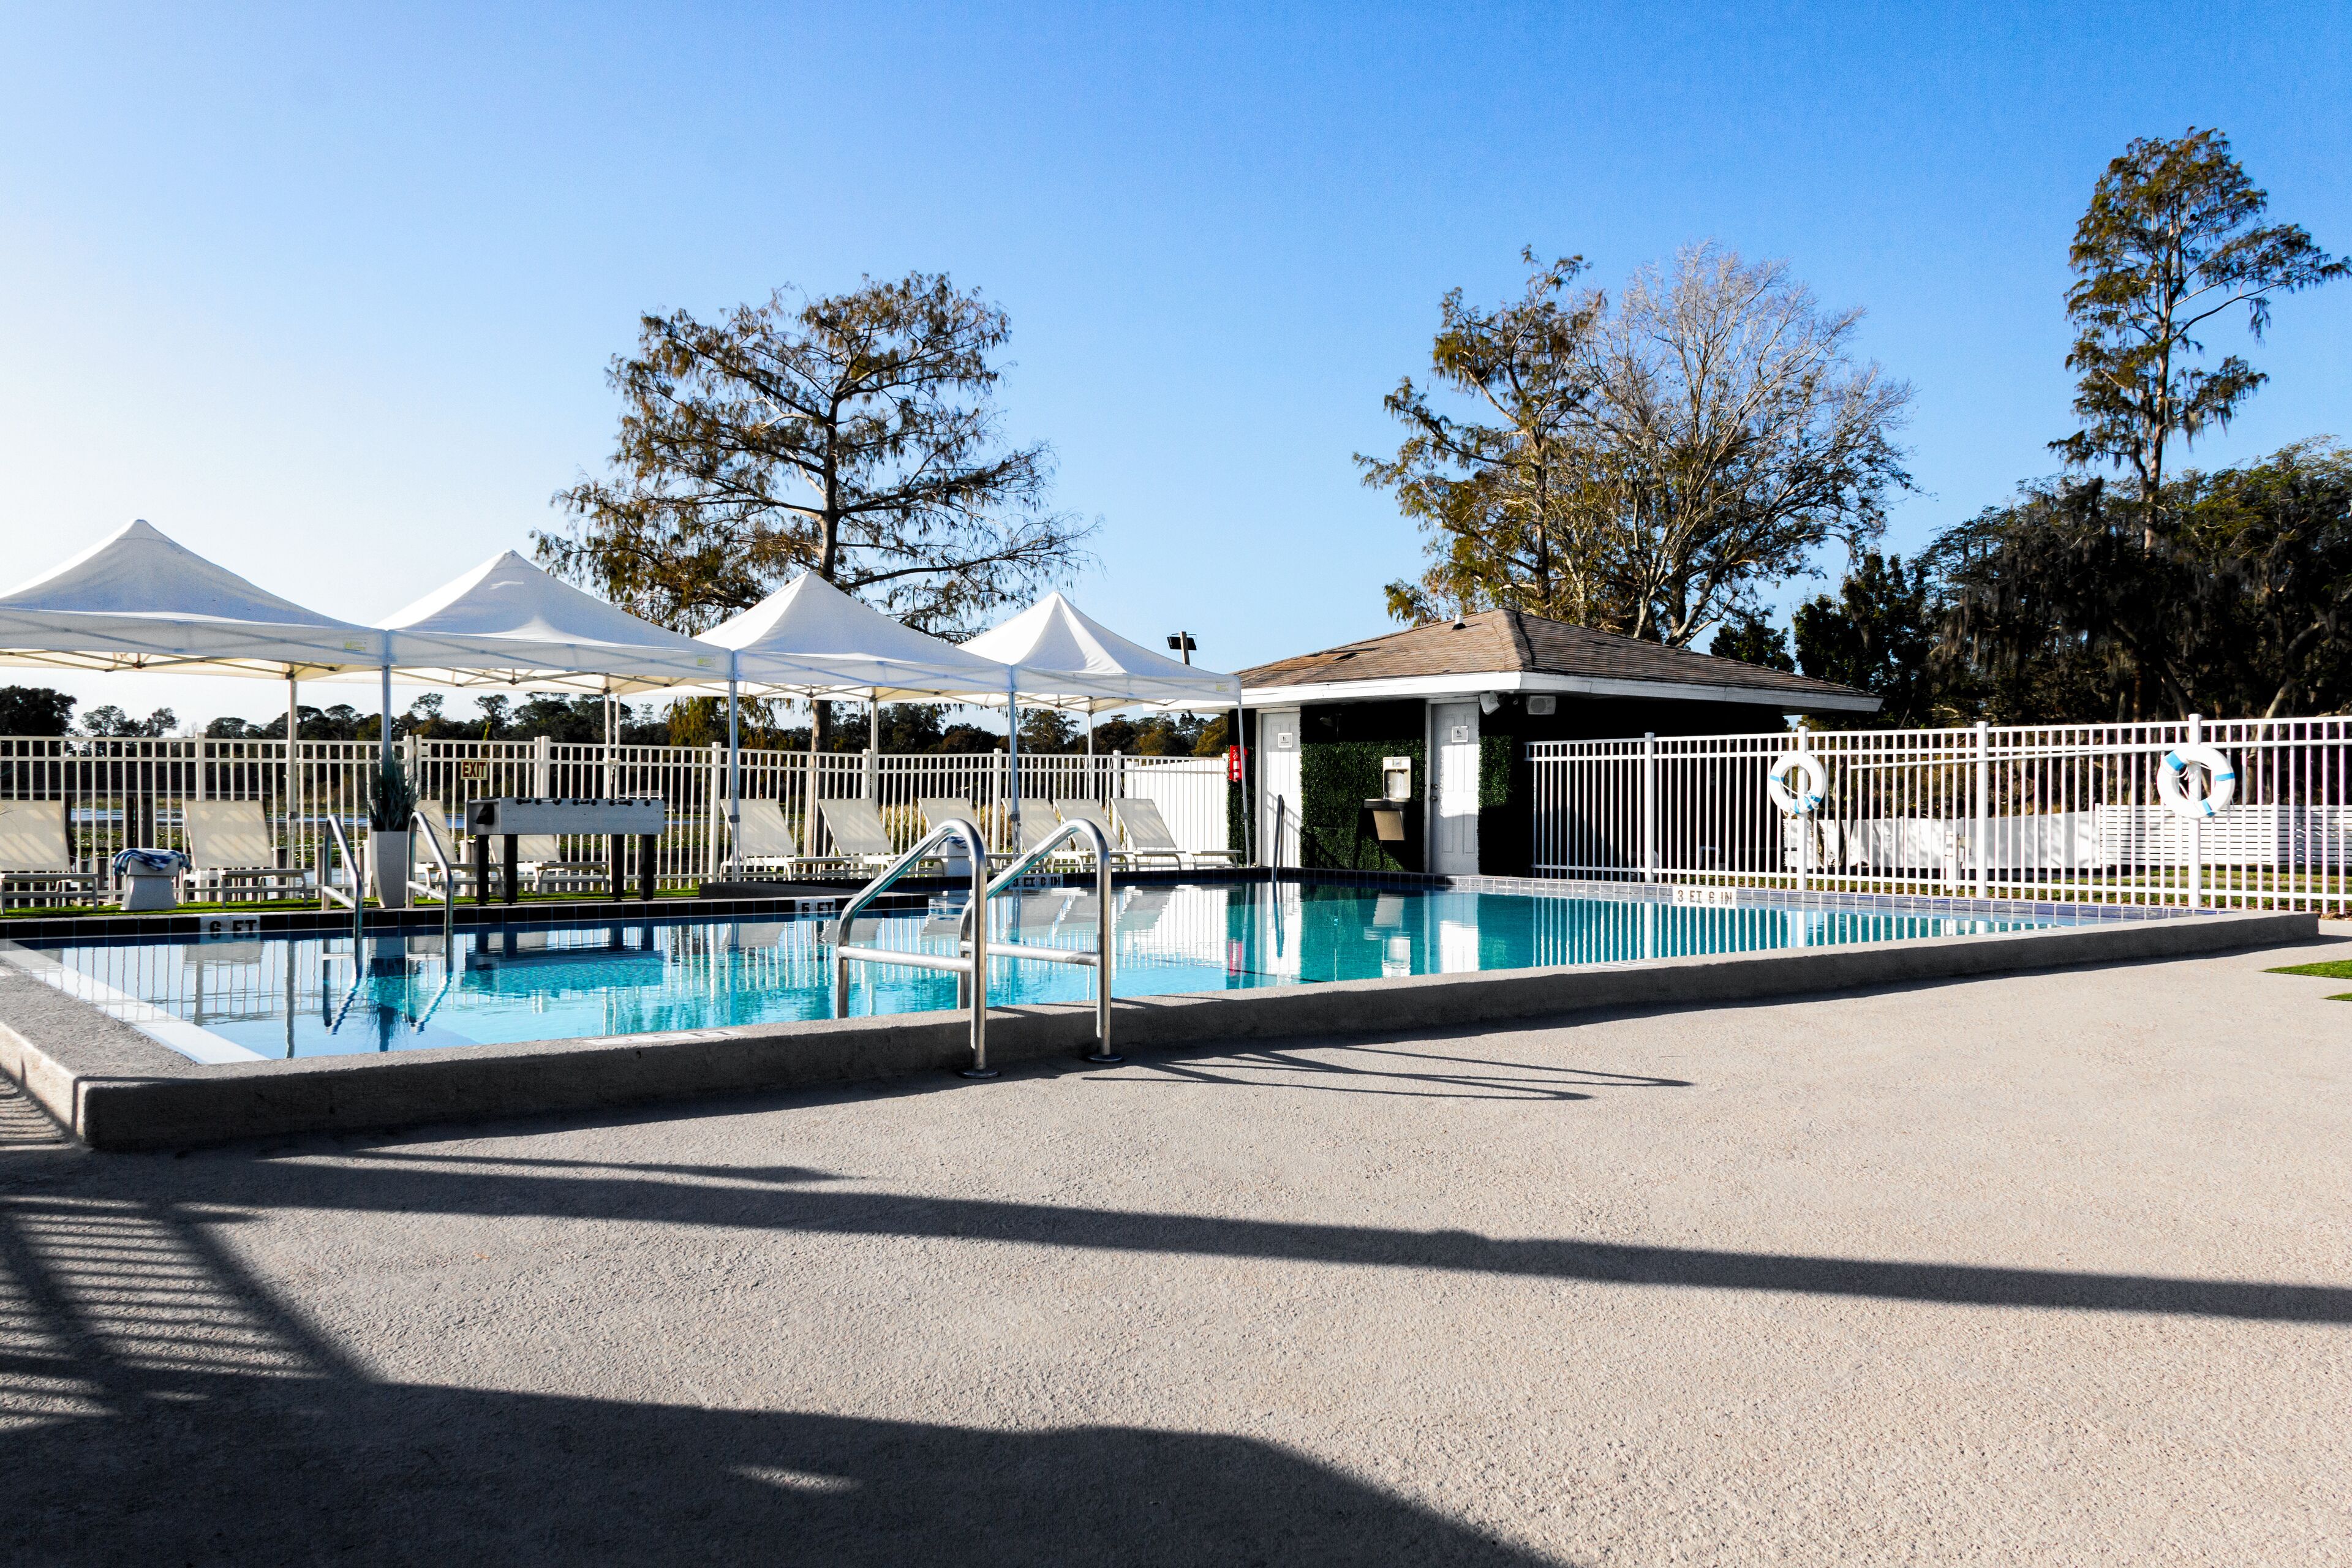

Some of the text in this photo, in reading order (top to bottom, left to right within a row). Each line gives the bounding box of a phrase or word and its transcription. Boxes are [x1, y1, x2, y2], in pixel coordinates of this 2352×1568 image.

[462, 761, 486, 777] EXIT
[817, 902, 834, 913] FT
[209, 919, 257, 933] 6 FT
